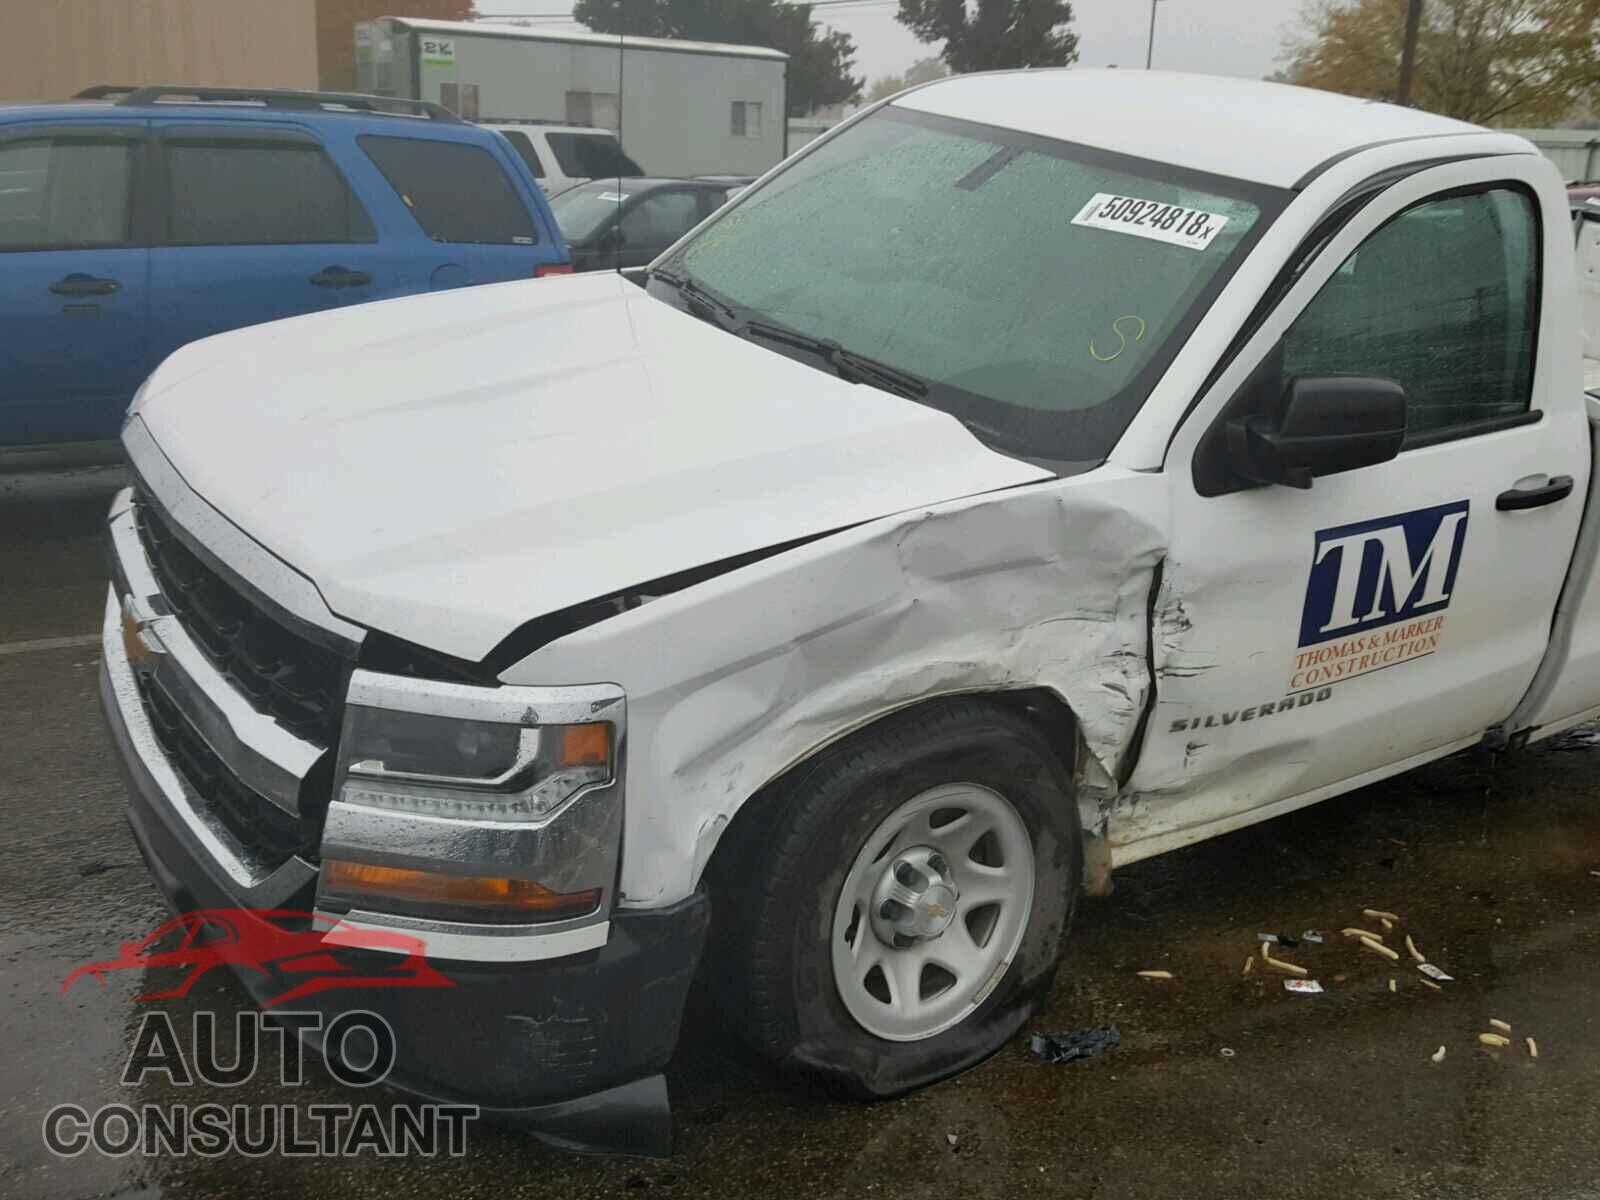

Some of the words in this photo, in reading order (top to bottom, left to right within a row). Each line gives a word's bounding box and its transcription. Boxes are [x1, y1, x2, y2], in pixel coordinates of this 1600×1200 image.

[1315, 511, 1468, 633] TM
[1290, 634, 1440, 689] CONSTRUCTION
[1295, 638, 1365, 670] THOMAS
[1367, 632, 1381, 649] &
[1383, 615, 1444, 646] MARKER
[1169, 686, 1333, 733] SILVERADO
